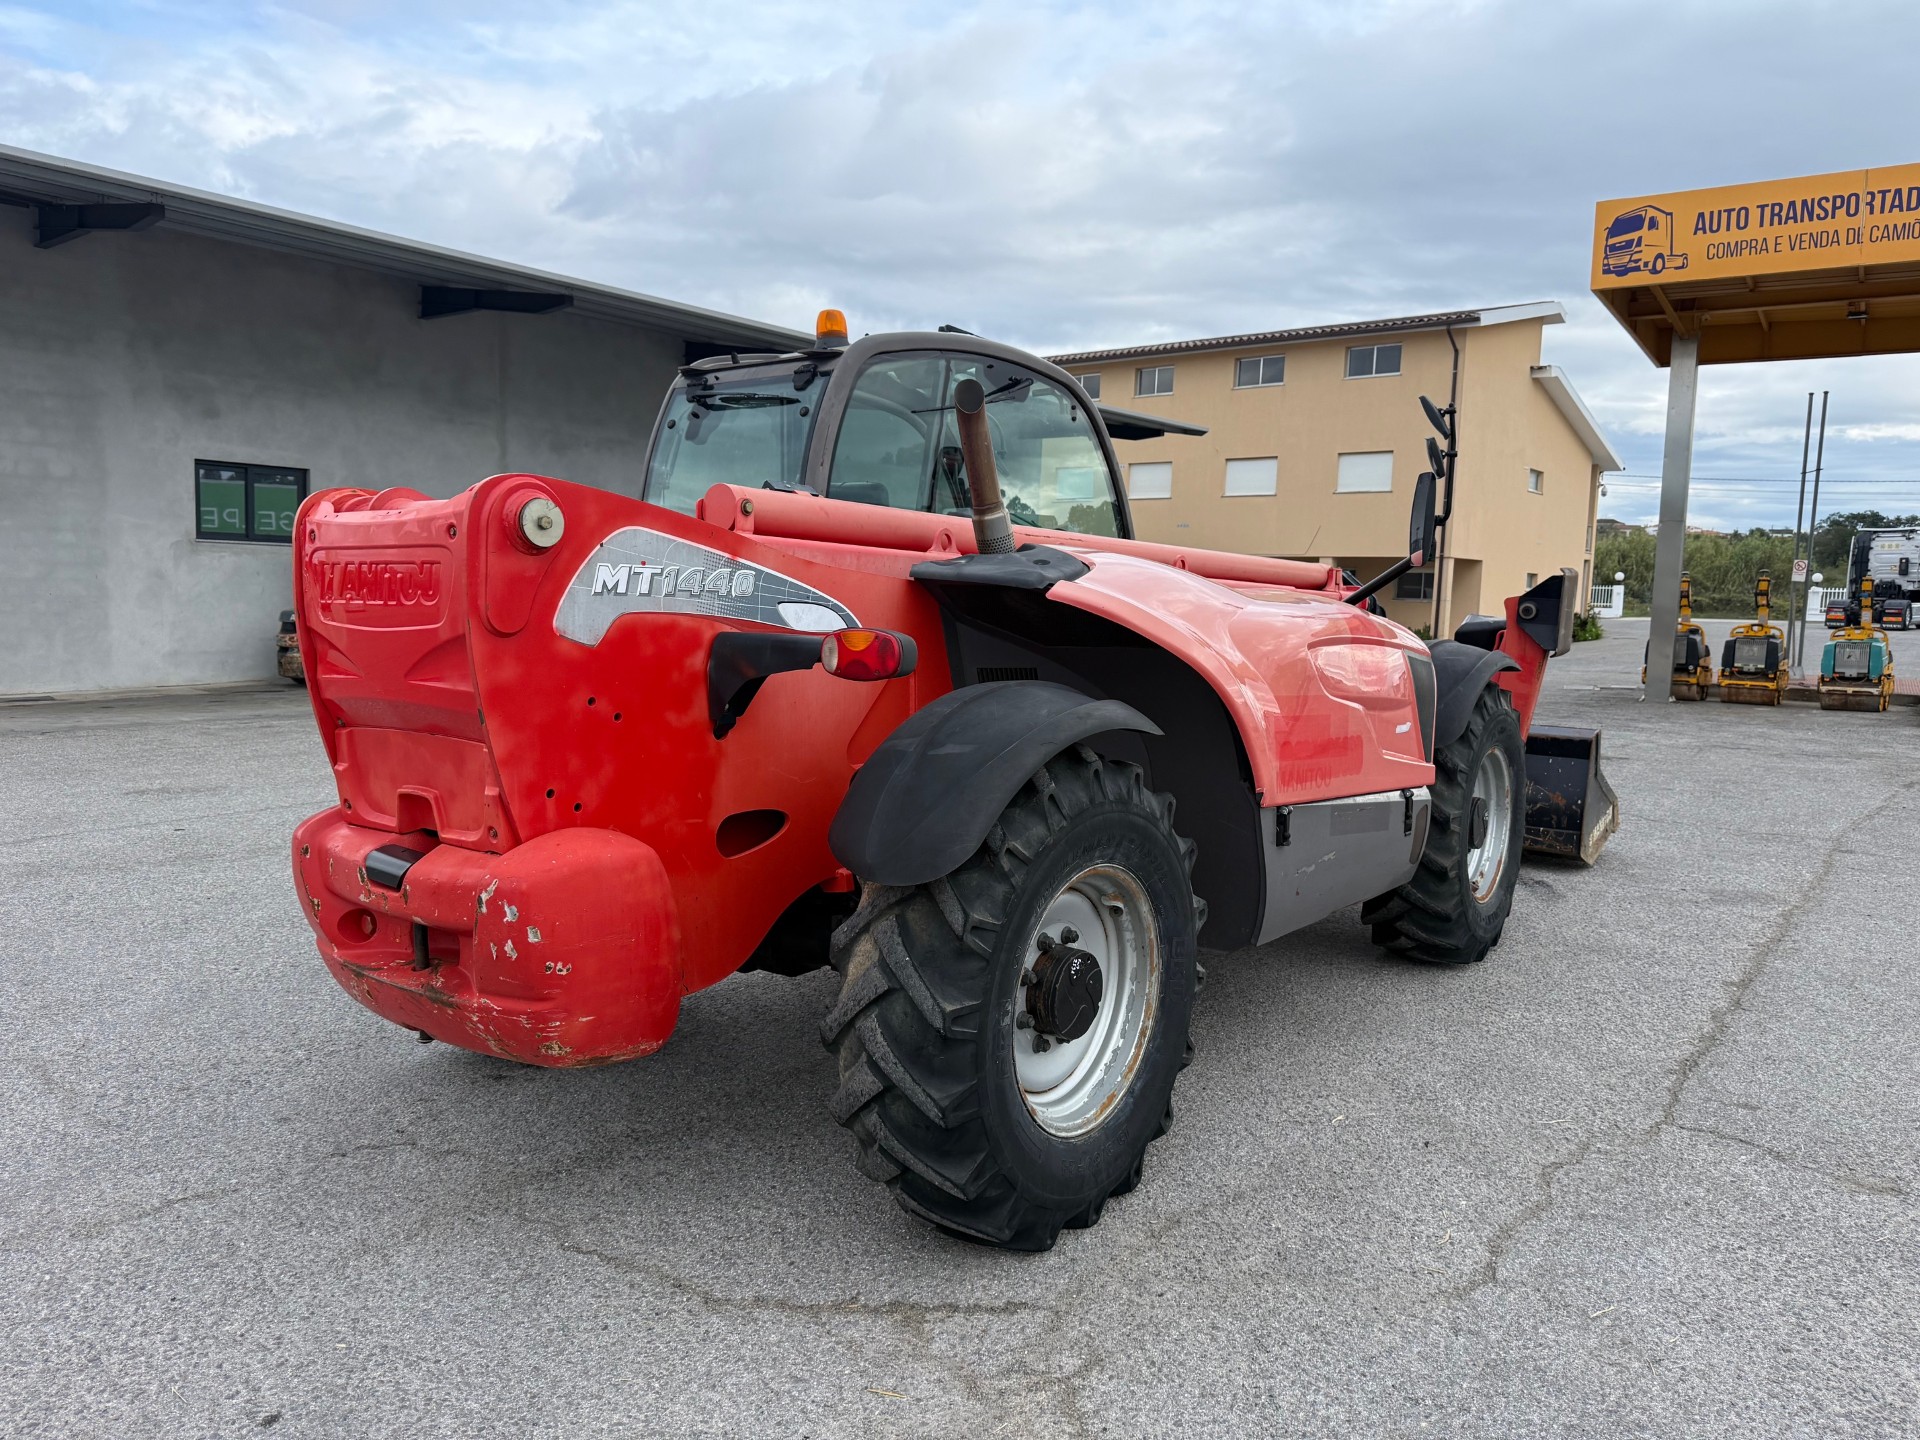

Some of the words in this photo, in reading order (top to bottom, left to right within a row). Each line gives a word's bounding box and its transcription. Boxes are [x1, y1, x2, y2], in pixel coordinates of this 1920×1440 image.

[1693, 206, 1750, 235] AUTO
[1706, 237, 1769, 260] COMPRA
[1774, 235, 1784, 253] E
[1788, 229, 1841, 251] VENDA
[318, 560, 442, 606] MANITOU
[592, 562, 757, 598] MT1440
